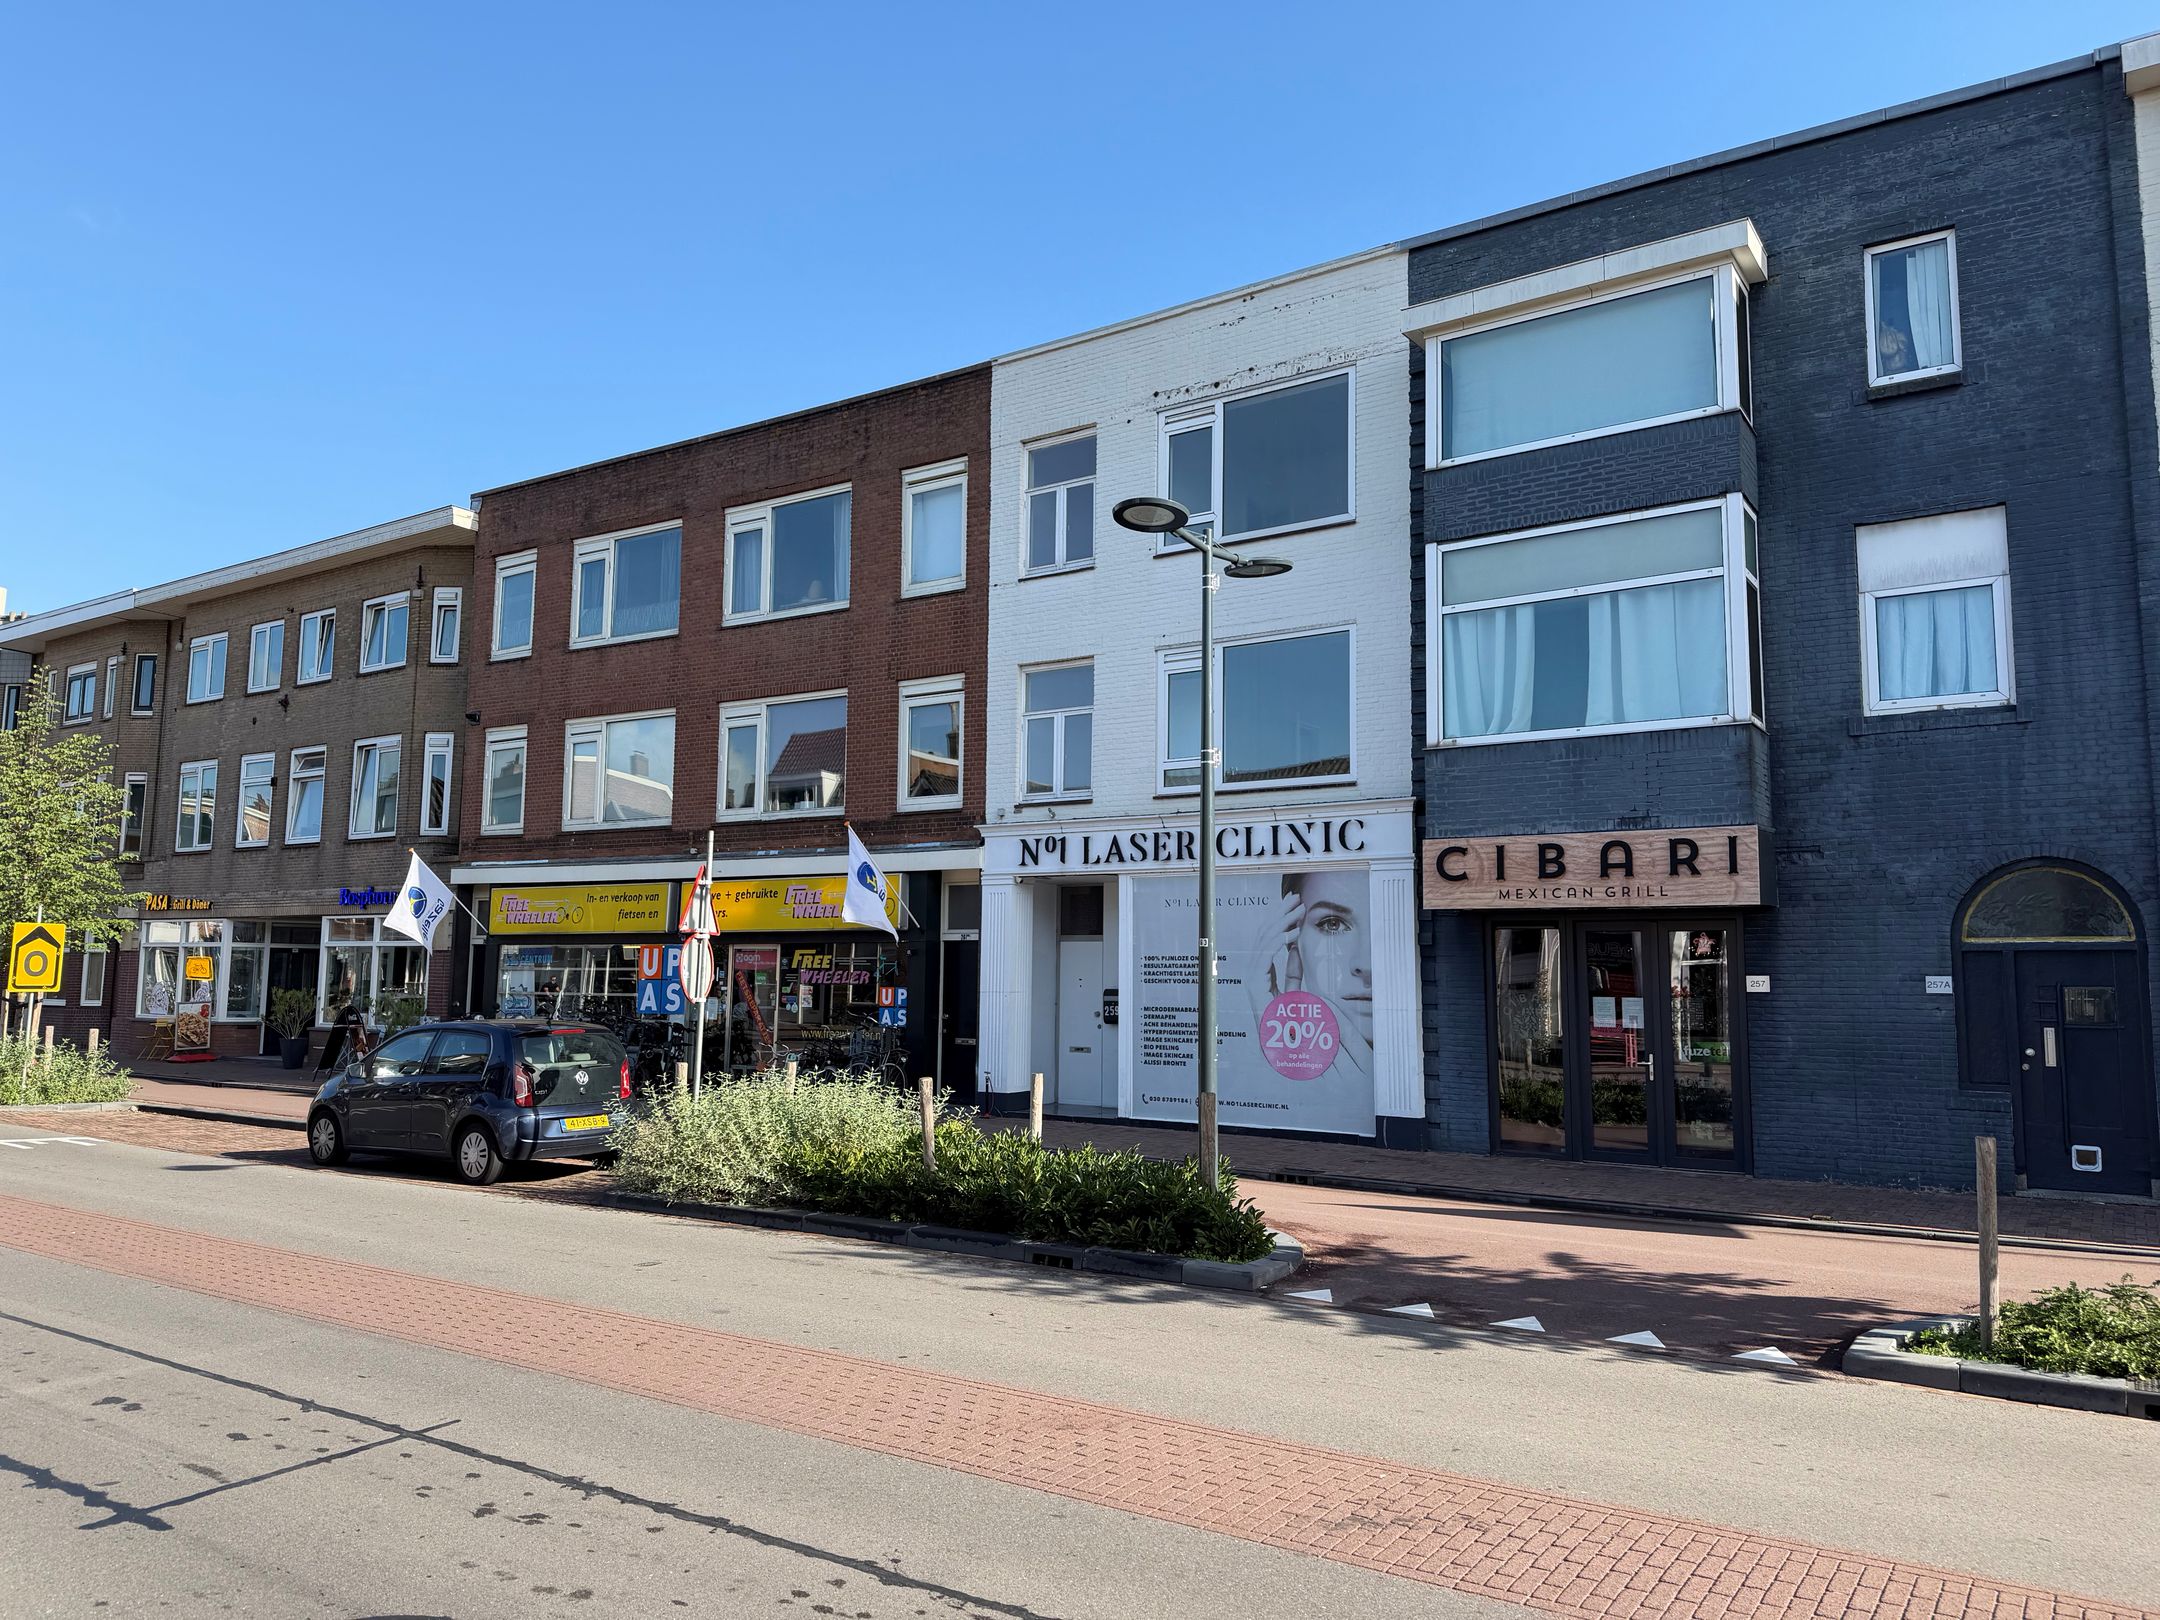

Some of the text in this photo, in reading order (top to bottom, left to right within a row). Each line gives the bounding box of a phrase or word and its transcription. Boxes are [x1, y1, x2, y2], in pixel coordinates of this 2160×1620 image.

[1082, 831, 1197, 864] LASER
[1216, 820, 1364, 858] CLINIC
[1436, 835, 1739, 881] CIBARI
[338, 886, 400, 909] Bosphoru
[586, 892, 659, 904] In- en verkoop van
[735, 888, 778, 902] gebruikte
[784, 885, 824, 904] FREE
[1499, 886, 1668, 900] MEXICAN GRILL
[500, 896, 530, 912] FREE
[1186, 898, 1222, 907] LAR
[1228, 896, 1269, 906] CLINIC
[505, 912, 558, 924] WHEELER
[618, 908, 658, 921] fietsen en
[792, 904, 844, 918] WHEEL
[791, 949, 833, 969] FREE
[800, 970, 870, 984] WHEELER
[882, 988, 908, 1005] UP
[881, 1009, 907, 1026] AS
[1104, 1005, 1118, 1016] 259
[1276, 1003, 1322, 1018] ACTIE
[1266, 1020, 1332, 1050] 20%
[1276, 1060, 1323, 1070] behandelingen
[1218, 1100, 1290, 1110] W.NO1LASERCLINIC.NL
